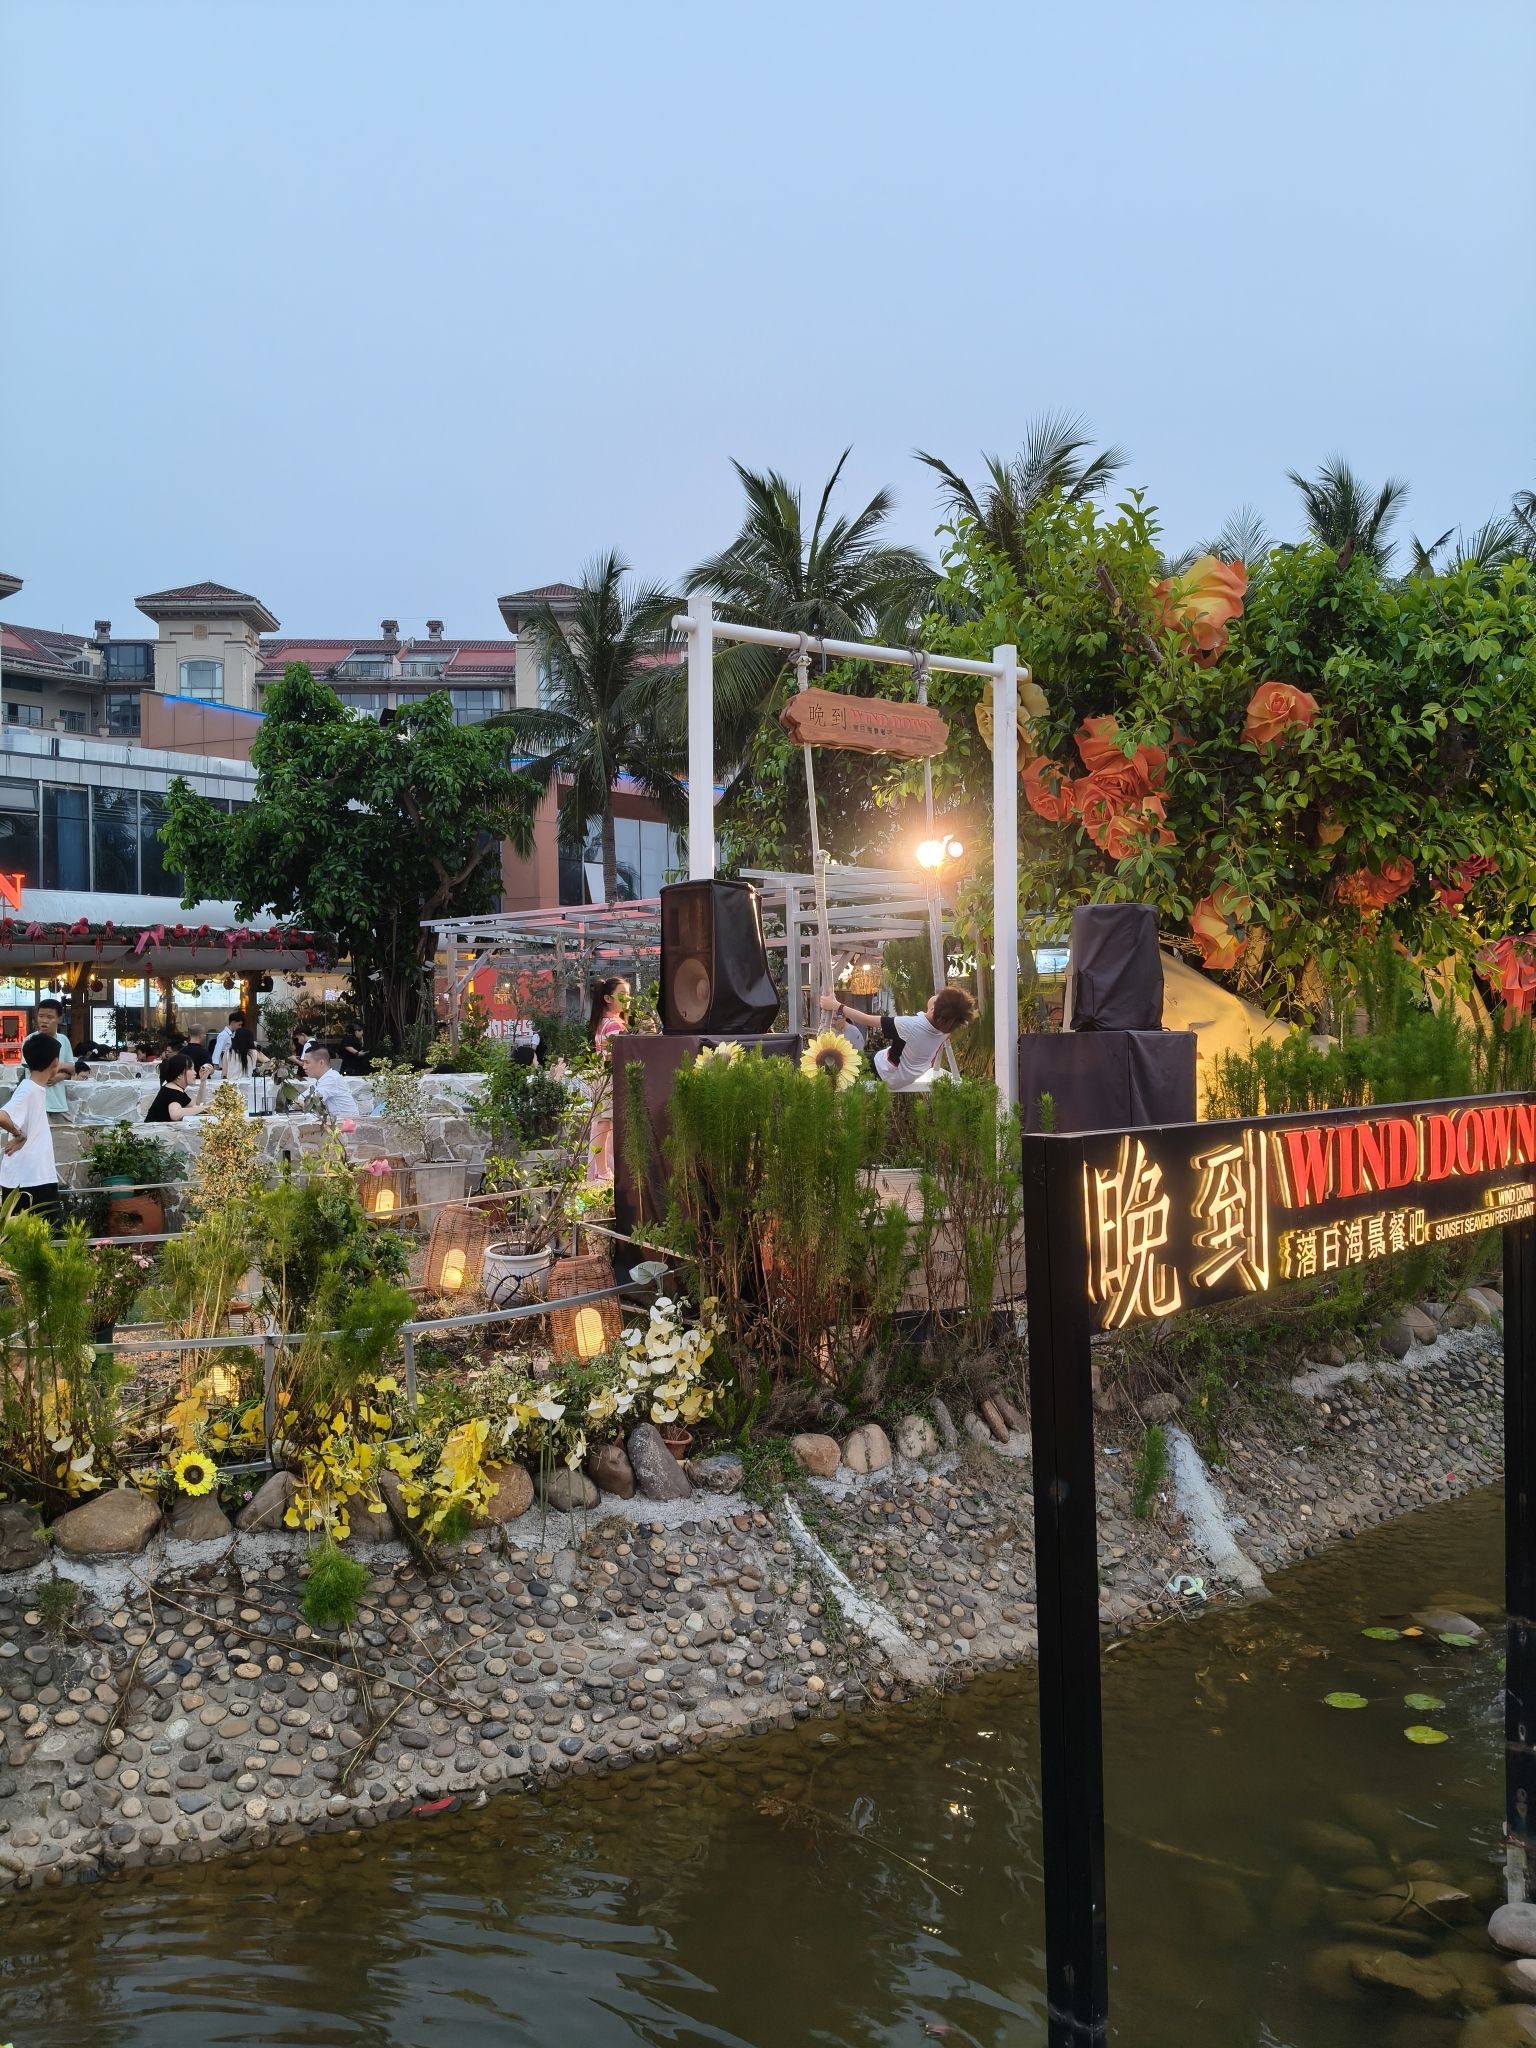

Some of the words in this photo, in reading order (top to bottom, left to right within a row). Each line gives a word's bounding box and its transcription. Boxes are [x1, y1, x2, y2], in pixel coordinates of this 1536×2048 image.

[808, 704, 847, 730] 晚到
[850, 708, 888, 727] WIND
[891, 715, 932, 734] DOWN
[1283, 1118, 1418, 1208] WIND
[1426, 1104, 1536, 1181] DOWN
[1498, 1188, 1516, 1206] WIND
[1516, 1183, 1534, 1202] DOWN
[1085, 1130, 1270, 1329] 晚到
[1435, 1220, 1465, 1241] SUNSET
[1464, 1211, 1496, 1234] SEAVIEW
[1495, 1201, 1536, 1224] RESTAURANT
[1296, 1208, 1425, 1279] 落日海景餐吧
